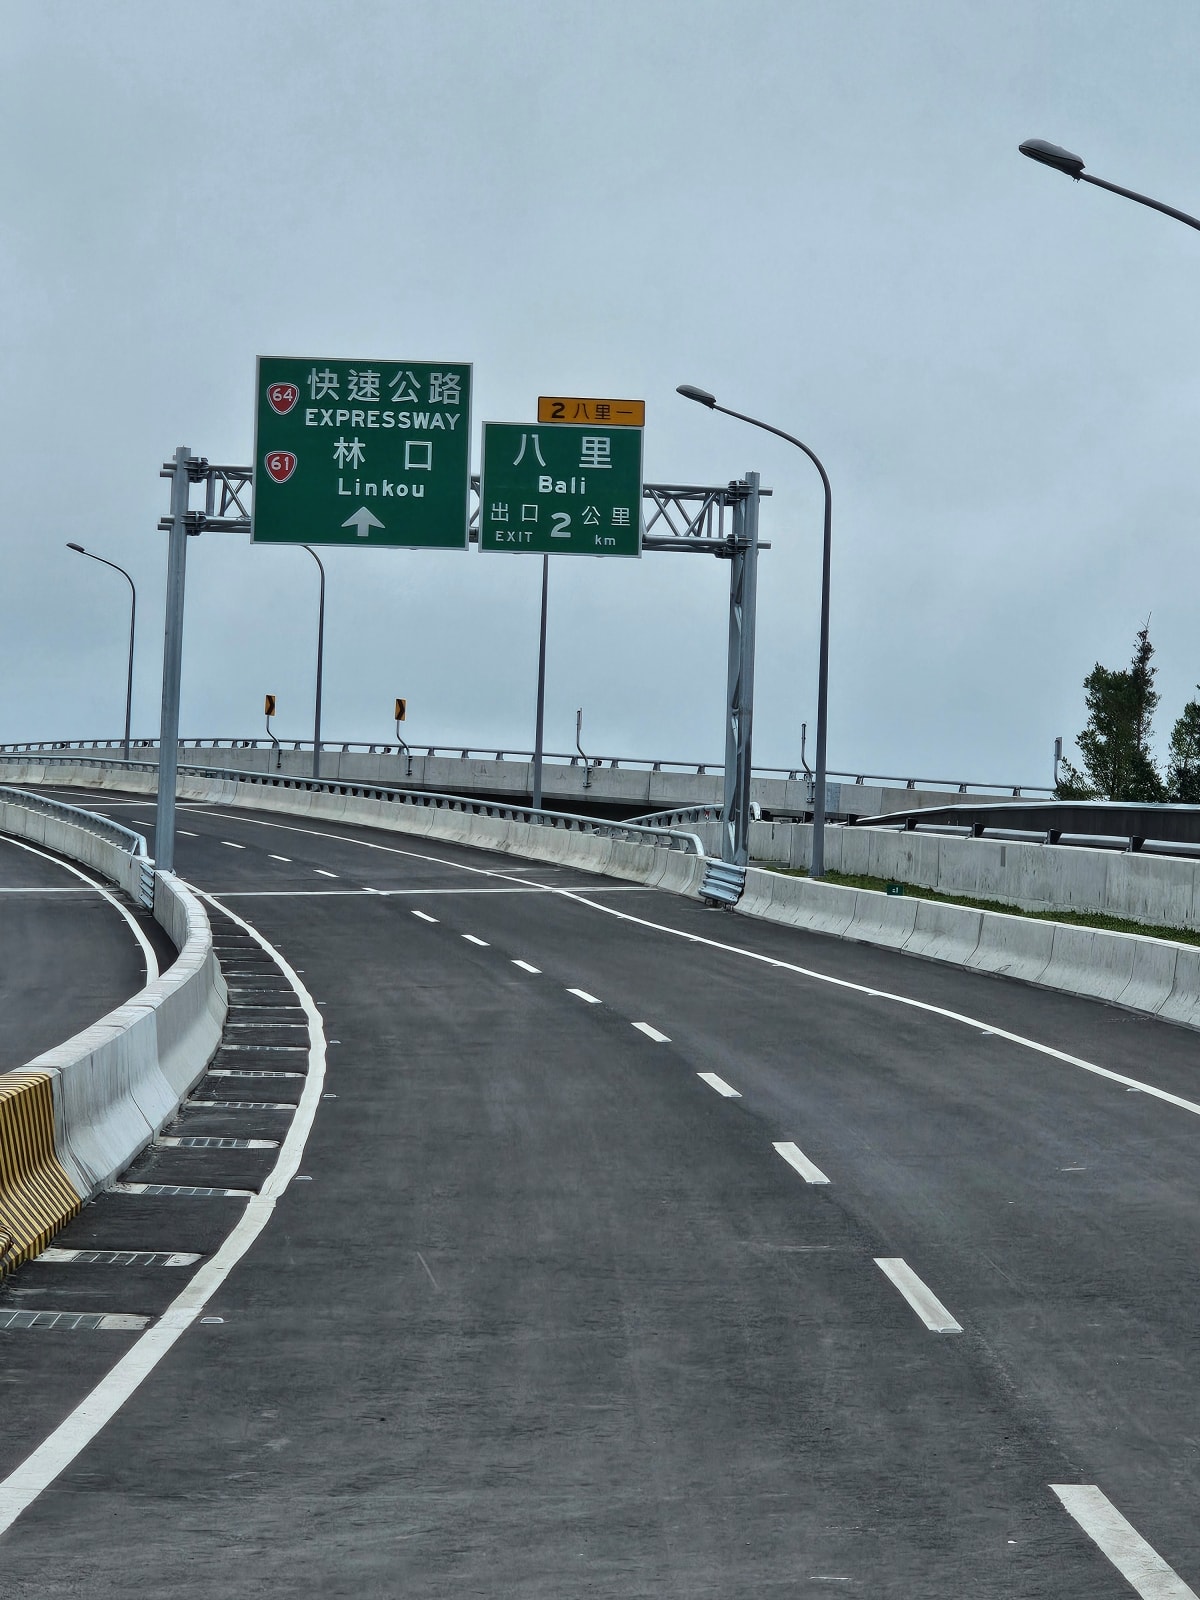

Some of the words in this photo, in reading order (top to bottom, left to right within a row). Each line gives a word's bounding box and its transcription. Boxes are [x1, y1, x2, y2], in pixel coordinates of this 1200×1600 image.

[272, 387, 293, 403] 64
[307, 367, 462, 405] 快速公路
[306, 408, 461, 430] EXPRESSWAY
[551, 402, 566, 419] 2
[572, 402, 633, 420] 八里一
[333, 436, 433, 471] 林口
[513, 433, 612, 469] 八里
[270, 456, 289, 471] 61
[338, 477, 425, 498] Linkou
[538, 475, 586, 495] Bali
[491, 502, 538, 523] 出口
[551, 512, 572, 538] 2
[582, 505, 631, 526] 公里
[495, 530, 533, 543] EXIT
[595, 534, 616, 546] km
